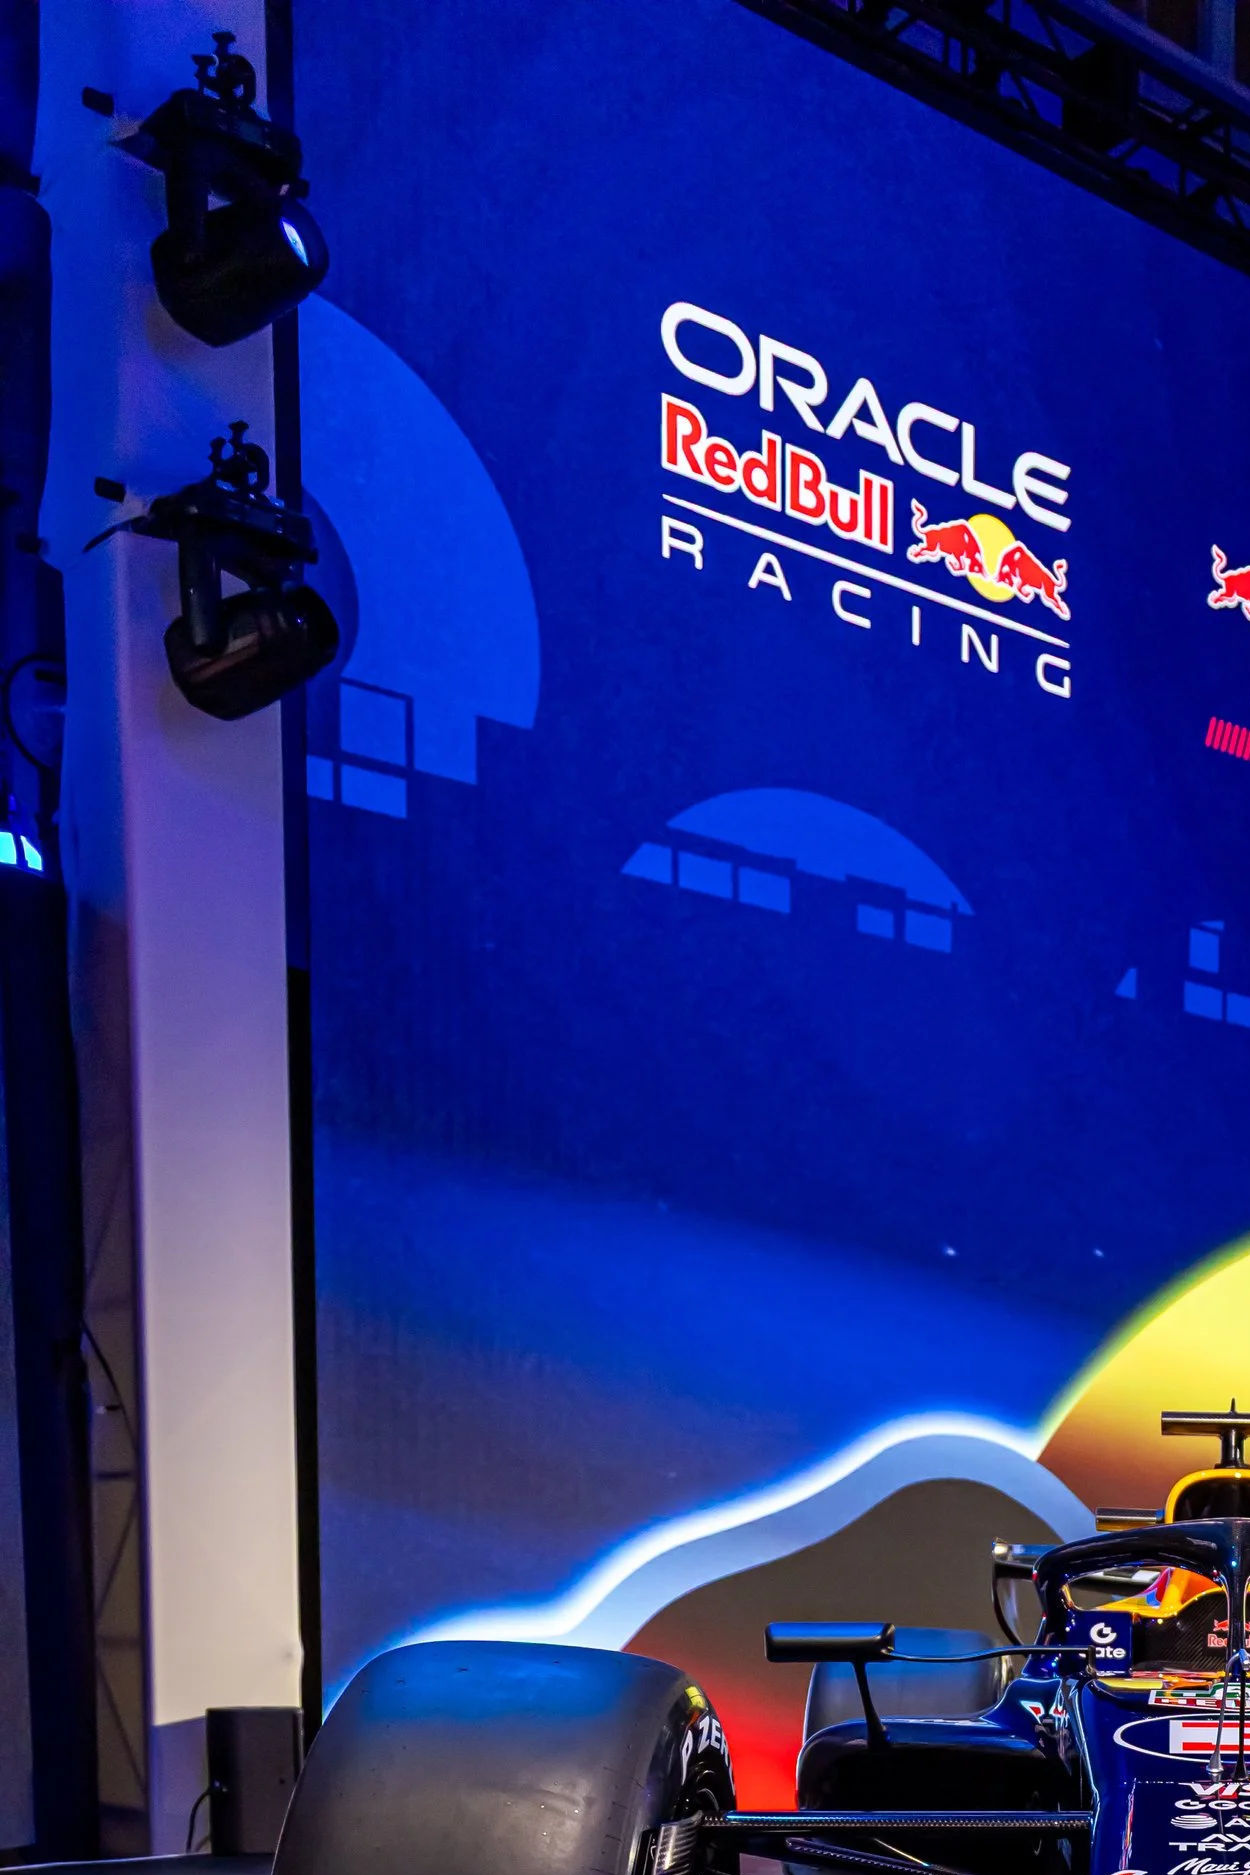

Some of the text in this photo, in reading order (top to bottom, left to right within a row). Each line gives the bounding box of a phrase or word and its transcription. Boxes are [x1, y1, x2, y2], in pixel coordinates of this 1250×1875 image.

[661, 302, 1071, 532] ORACLE
[662, 516, 1071, 699] RACING
[1079, 1647, 1127, 1659] ate
[1167, 1857, 1240, 1875] Maui
